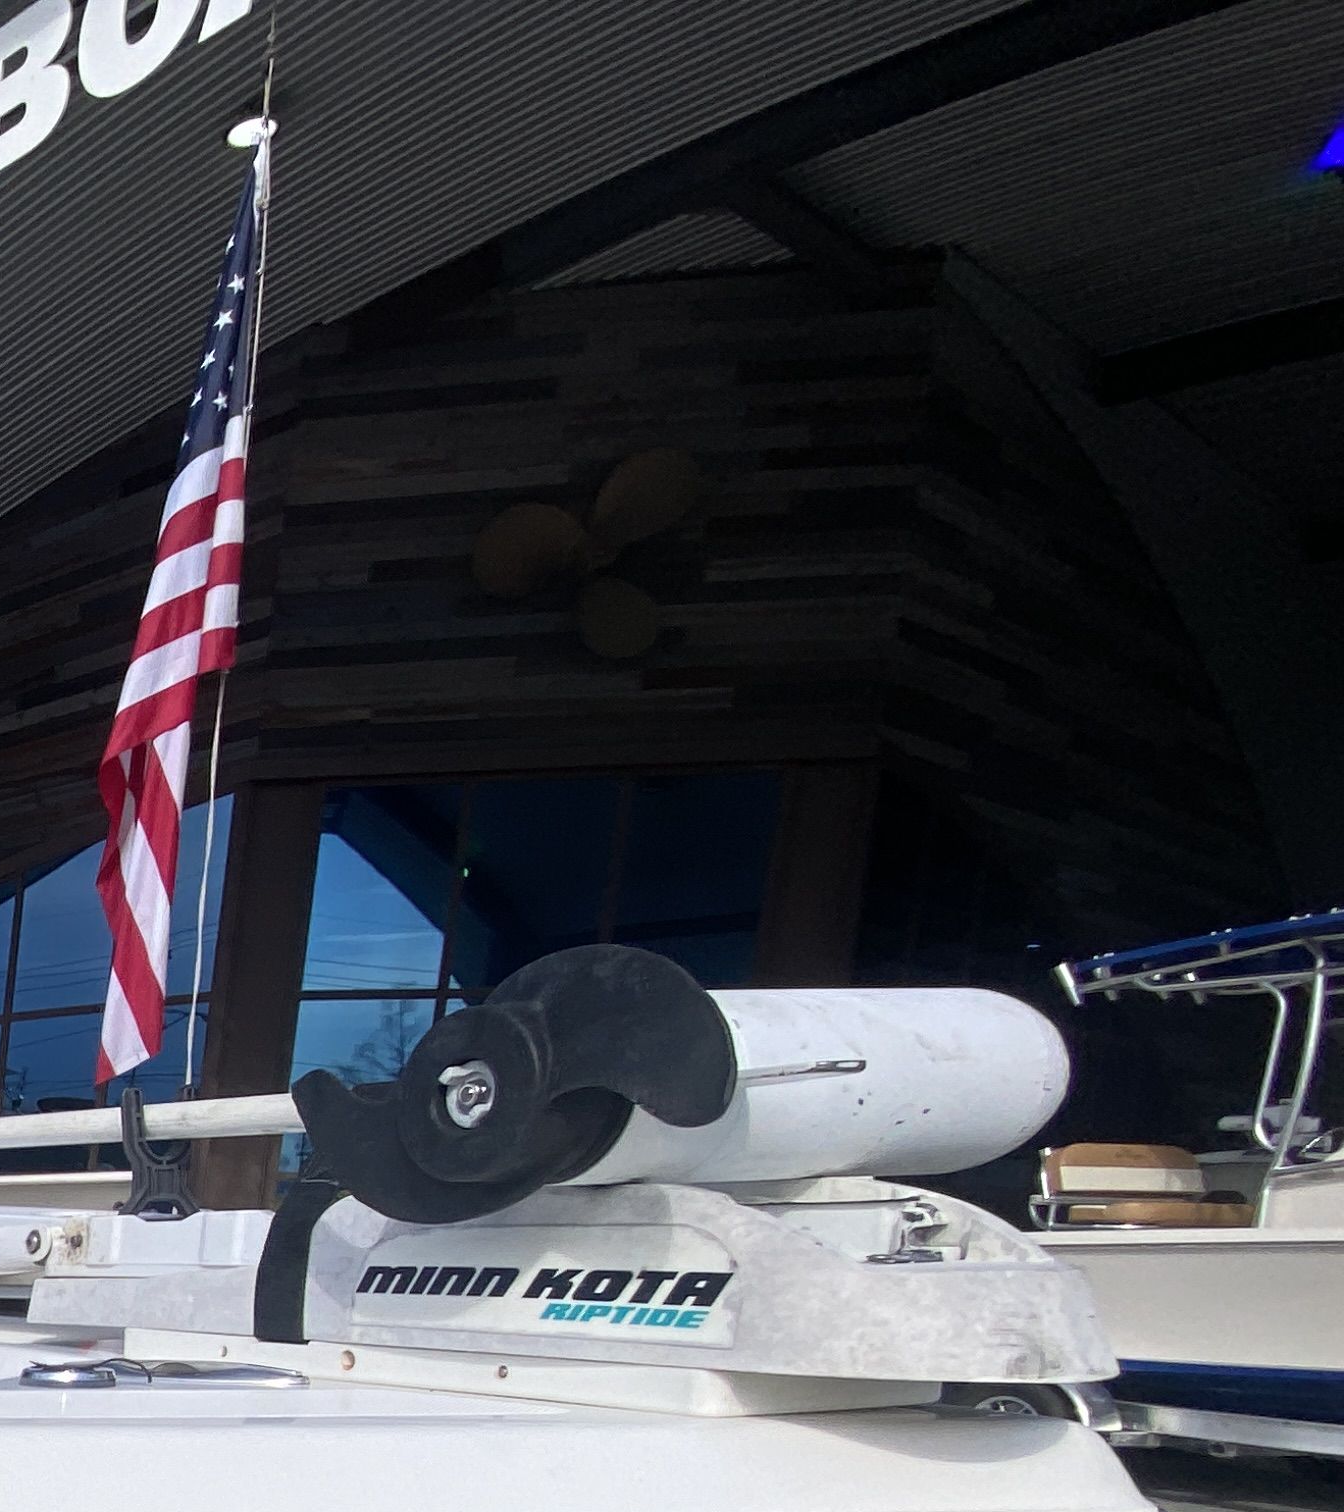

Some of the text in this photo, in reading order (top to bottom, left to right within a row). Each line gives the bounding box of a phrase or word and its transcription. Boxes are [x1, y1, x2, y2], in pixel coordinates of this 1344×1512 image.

[357, 1265, 734, 1307] MINN KOTA
[539, 1302, 710, 1330] RIPTIDE
